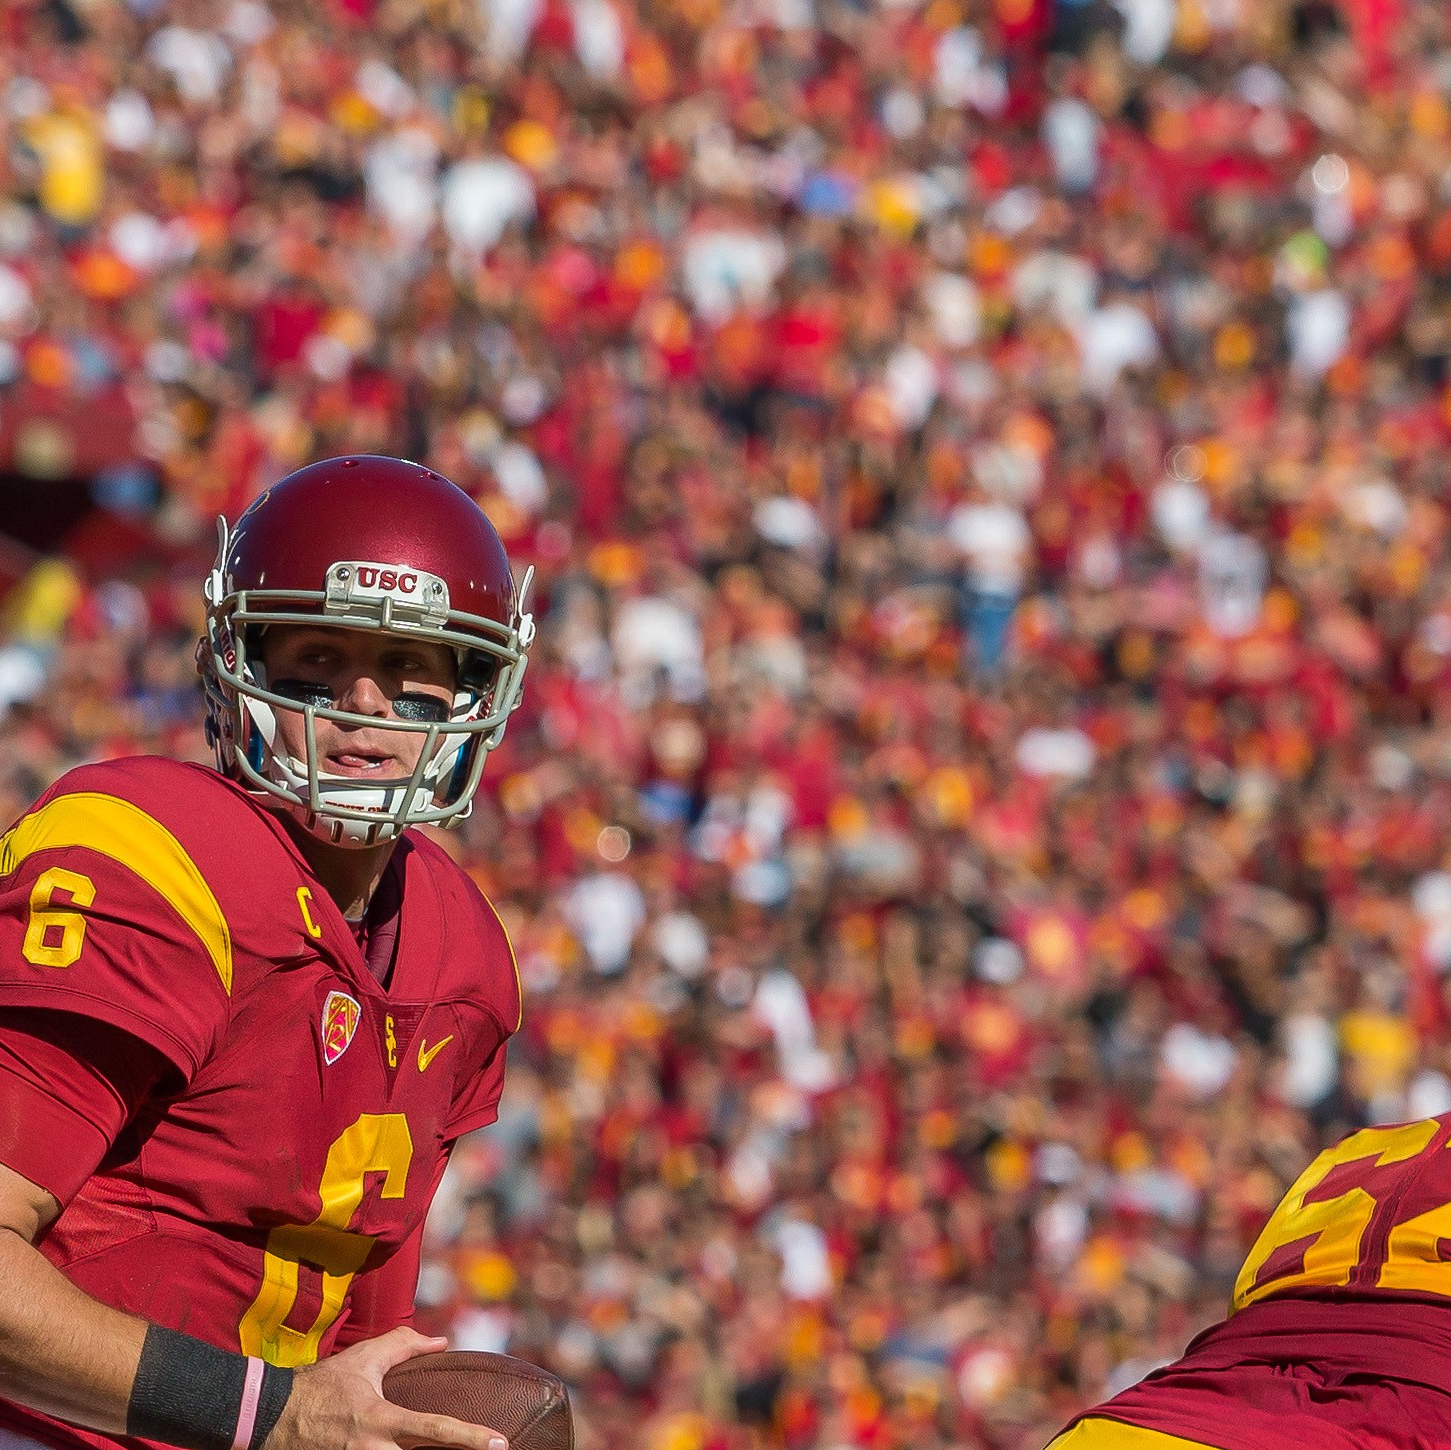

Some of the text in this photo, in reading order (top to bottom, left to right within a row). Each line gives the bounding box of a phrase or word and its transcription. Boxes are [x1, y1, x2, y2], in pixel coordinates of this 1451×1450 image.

[358, 566, 418, 594] USC
[22, 867, 96, 968] 6
[296, 886, 322, 938] C
[239, 1112, 414, 1369] 6
